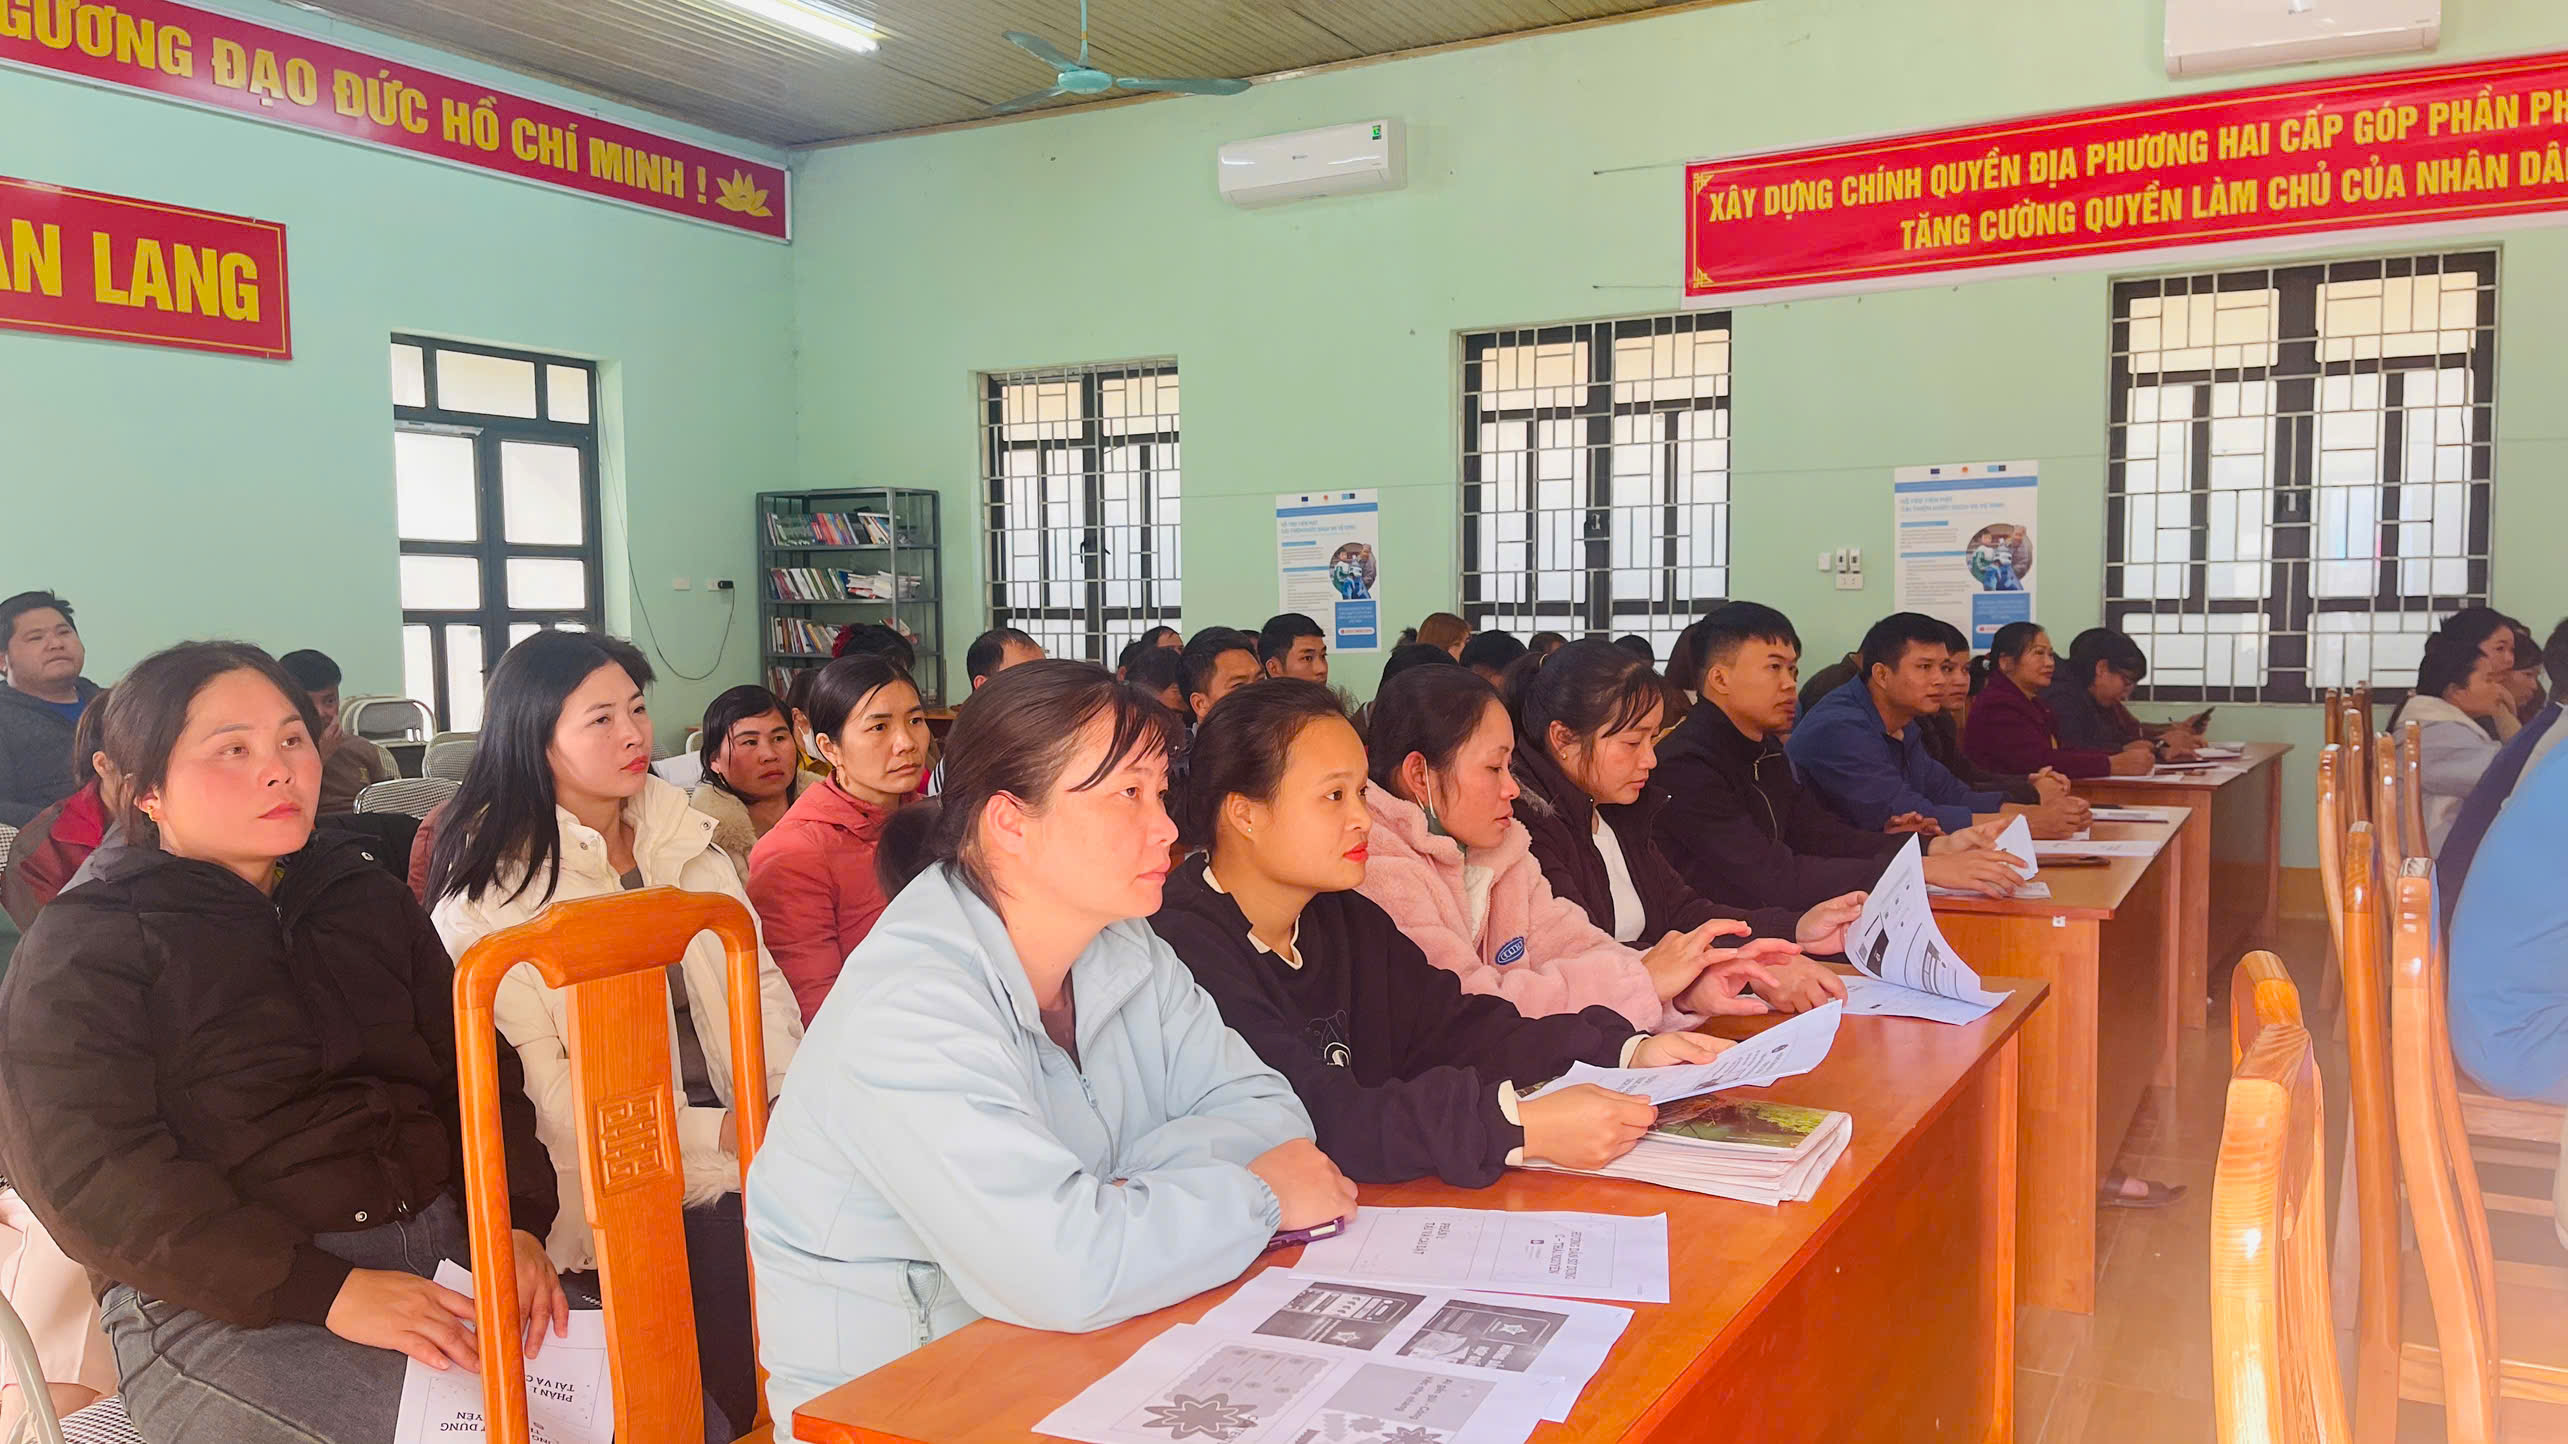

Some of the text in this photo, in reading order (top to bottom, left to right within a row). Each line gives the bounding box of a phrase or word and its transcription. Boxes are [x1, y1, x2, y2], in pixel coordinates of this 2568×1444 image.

[211, 37, 318, 106] ĐẠO
[329, 63, 429, 134] ĐỨC
[441, 95, 500, 152] HỒ
[511, 122, 579, 173] CHÍ
[588, 137, 685, 199] MINH
[697, 166, 707, 204] !
[1709, 181, 1756, 222] XÂY
[1764, 179, 1833, 220] DỤNG
[1842, 164, 1922, 206] CHÍNH
[1930, 148, 2021, 199] QUYỀN
[2029, 149, 2077, 191] ĐỊA
[2086, 129, 2209, 177] PHƯƠNG
[2218, 123, 2270, 160] HAI
[2280, 103, 2343, 153] CẤP
[2353, 101, 2417, 145] GÓP
[2428, 84, 2519, 137] PHẦN
[1901, 141, 2568, 250] TĂNG CƯỜNG QUYỀN LÀM CHỦ CỦA NHÂN DÂ
[92, 231, 261, 323] LANG
